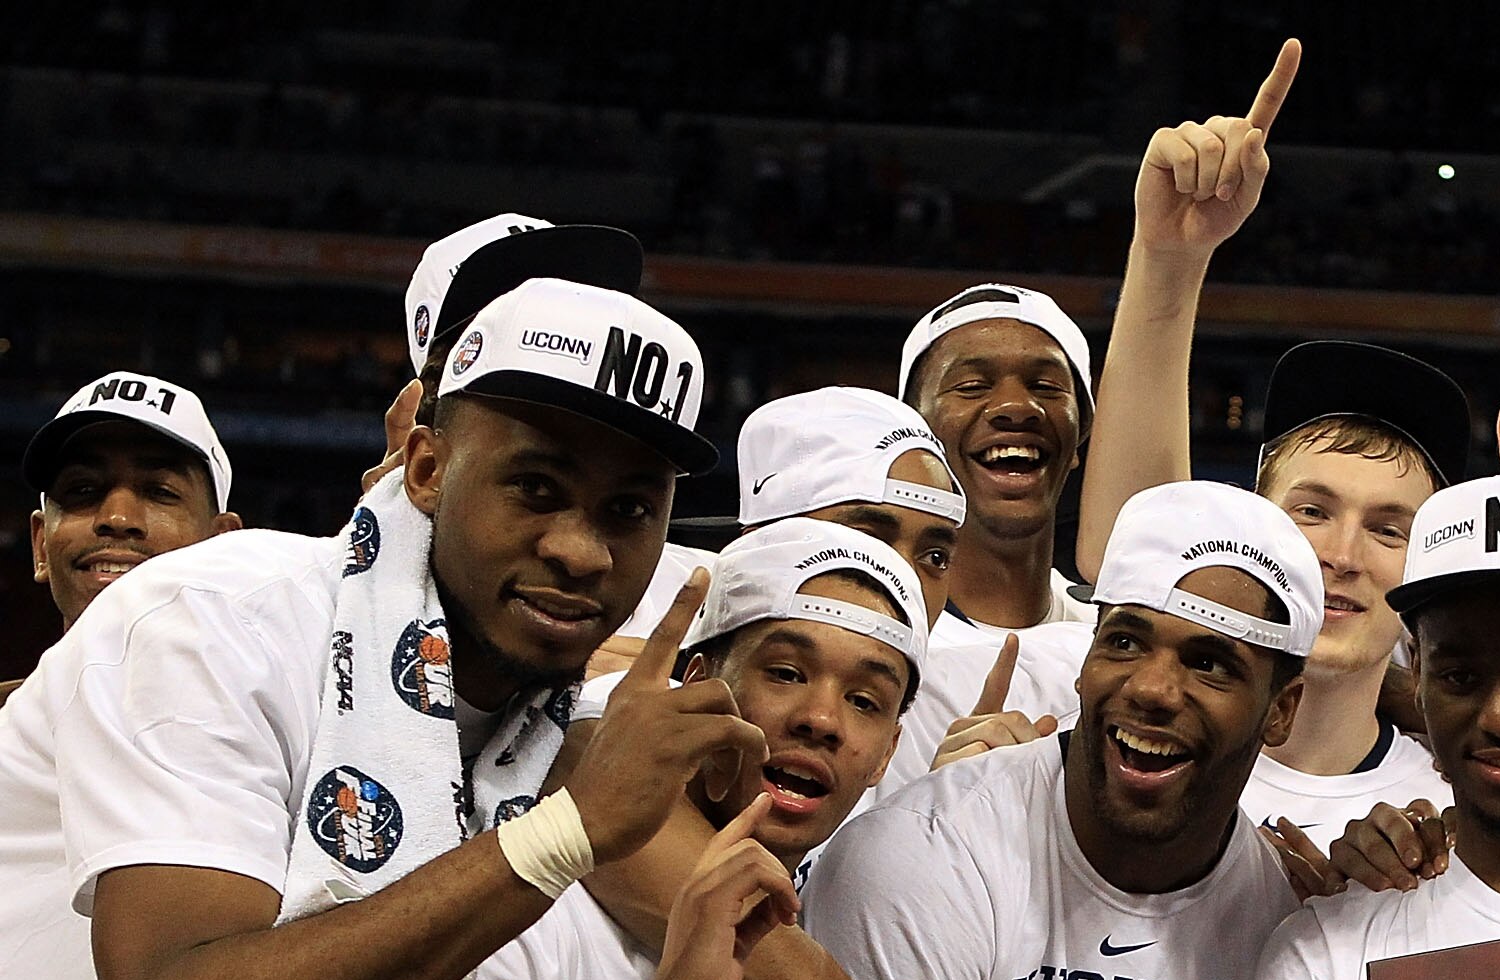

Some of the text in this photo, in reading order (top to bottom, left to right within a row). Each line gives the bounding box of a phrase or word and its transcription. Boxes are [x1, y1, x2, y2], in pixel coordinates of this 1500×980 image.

[521, 329, 592, 362] UCONN
[1424, 518, 1475, 550] UCONN
[793, 547, 910, 602] NATIONAL CHAMPIONS
[1180, 539, 1294, 594] NATIONAL CHAMPIONS
